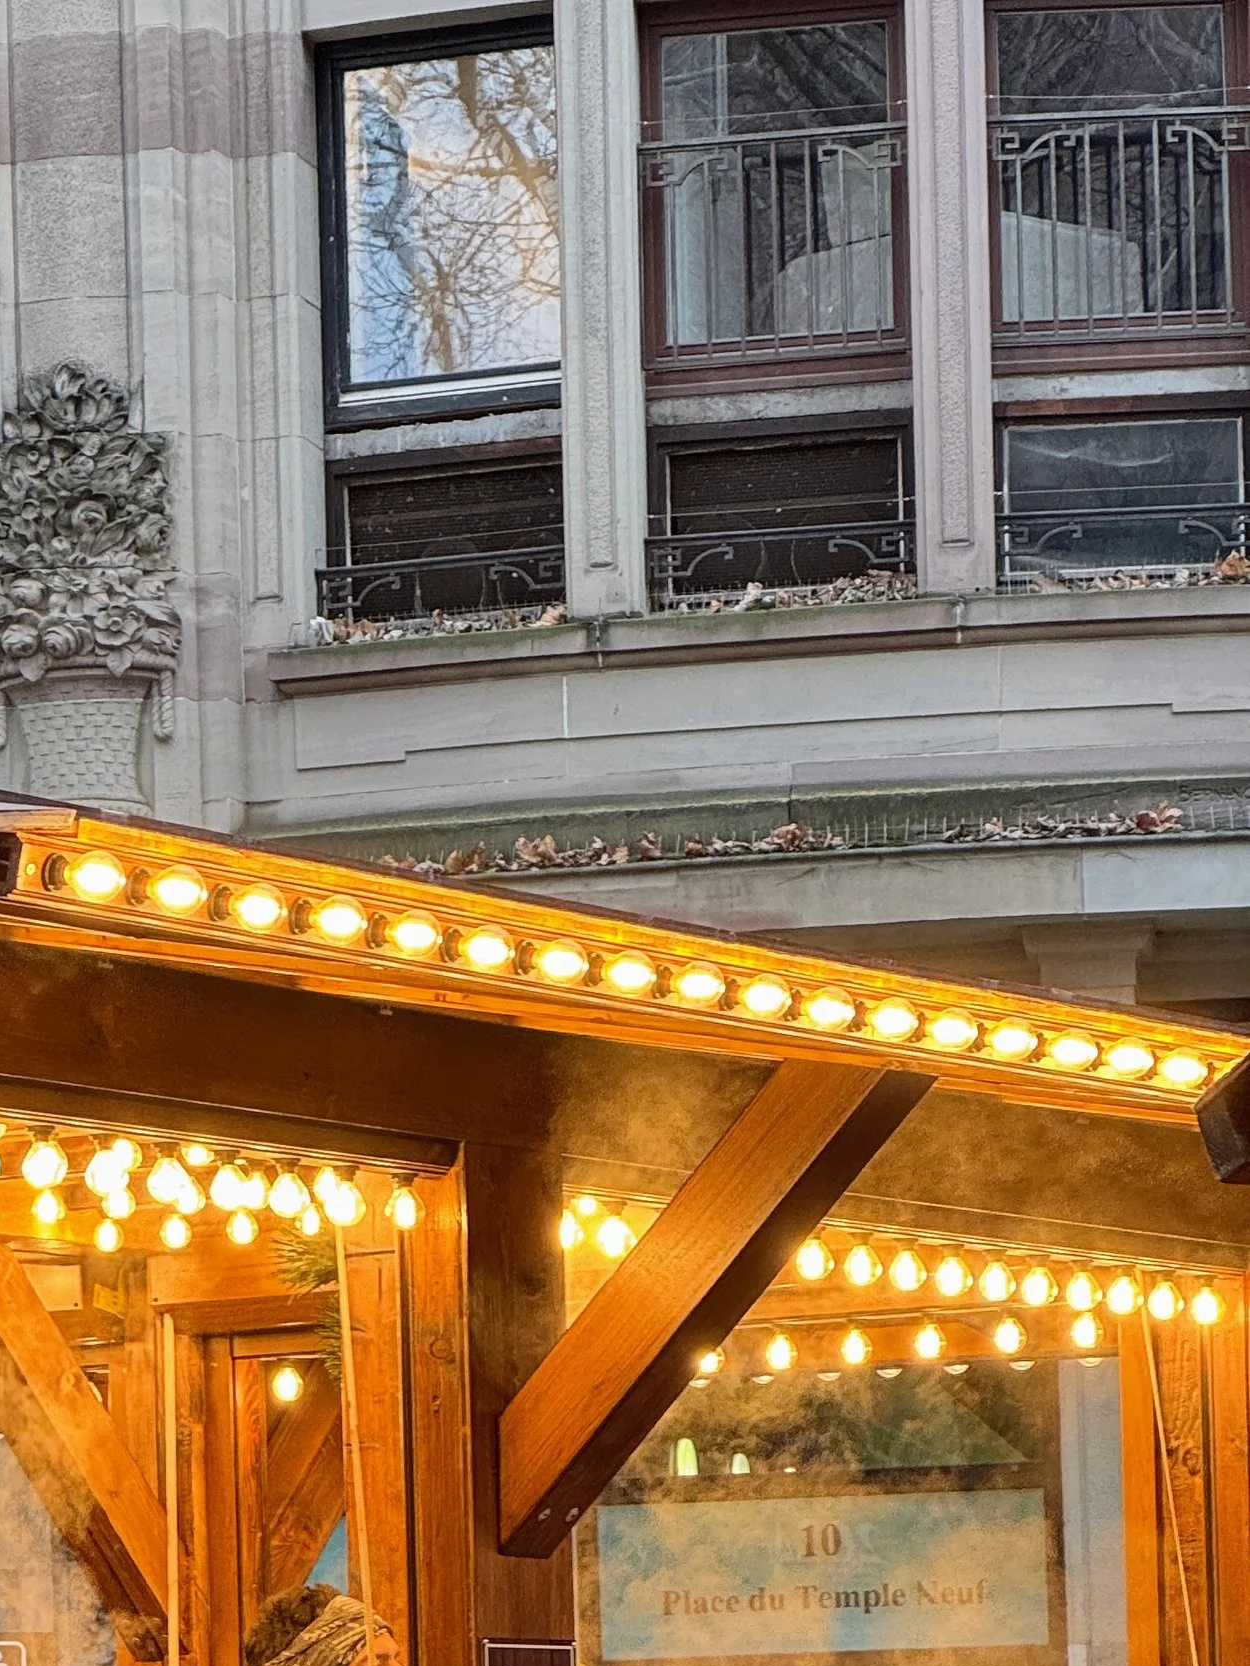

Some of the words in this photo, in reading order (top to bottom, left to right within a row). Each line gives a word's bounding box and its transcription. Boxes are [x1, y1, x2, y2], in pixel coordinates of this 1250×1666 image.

[800, 1522, 842, 1557] 10
[662, 1588, 739, 1617] Place
[749, 1587, 785, 1612] du
[796, 1582, 907, 1614] Temple
[917, 1579, 988, 1607] Neuf
